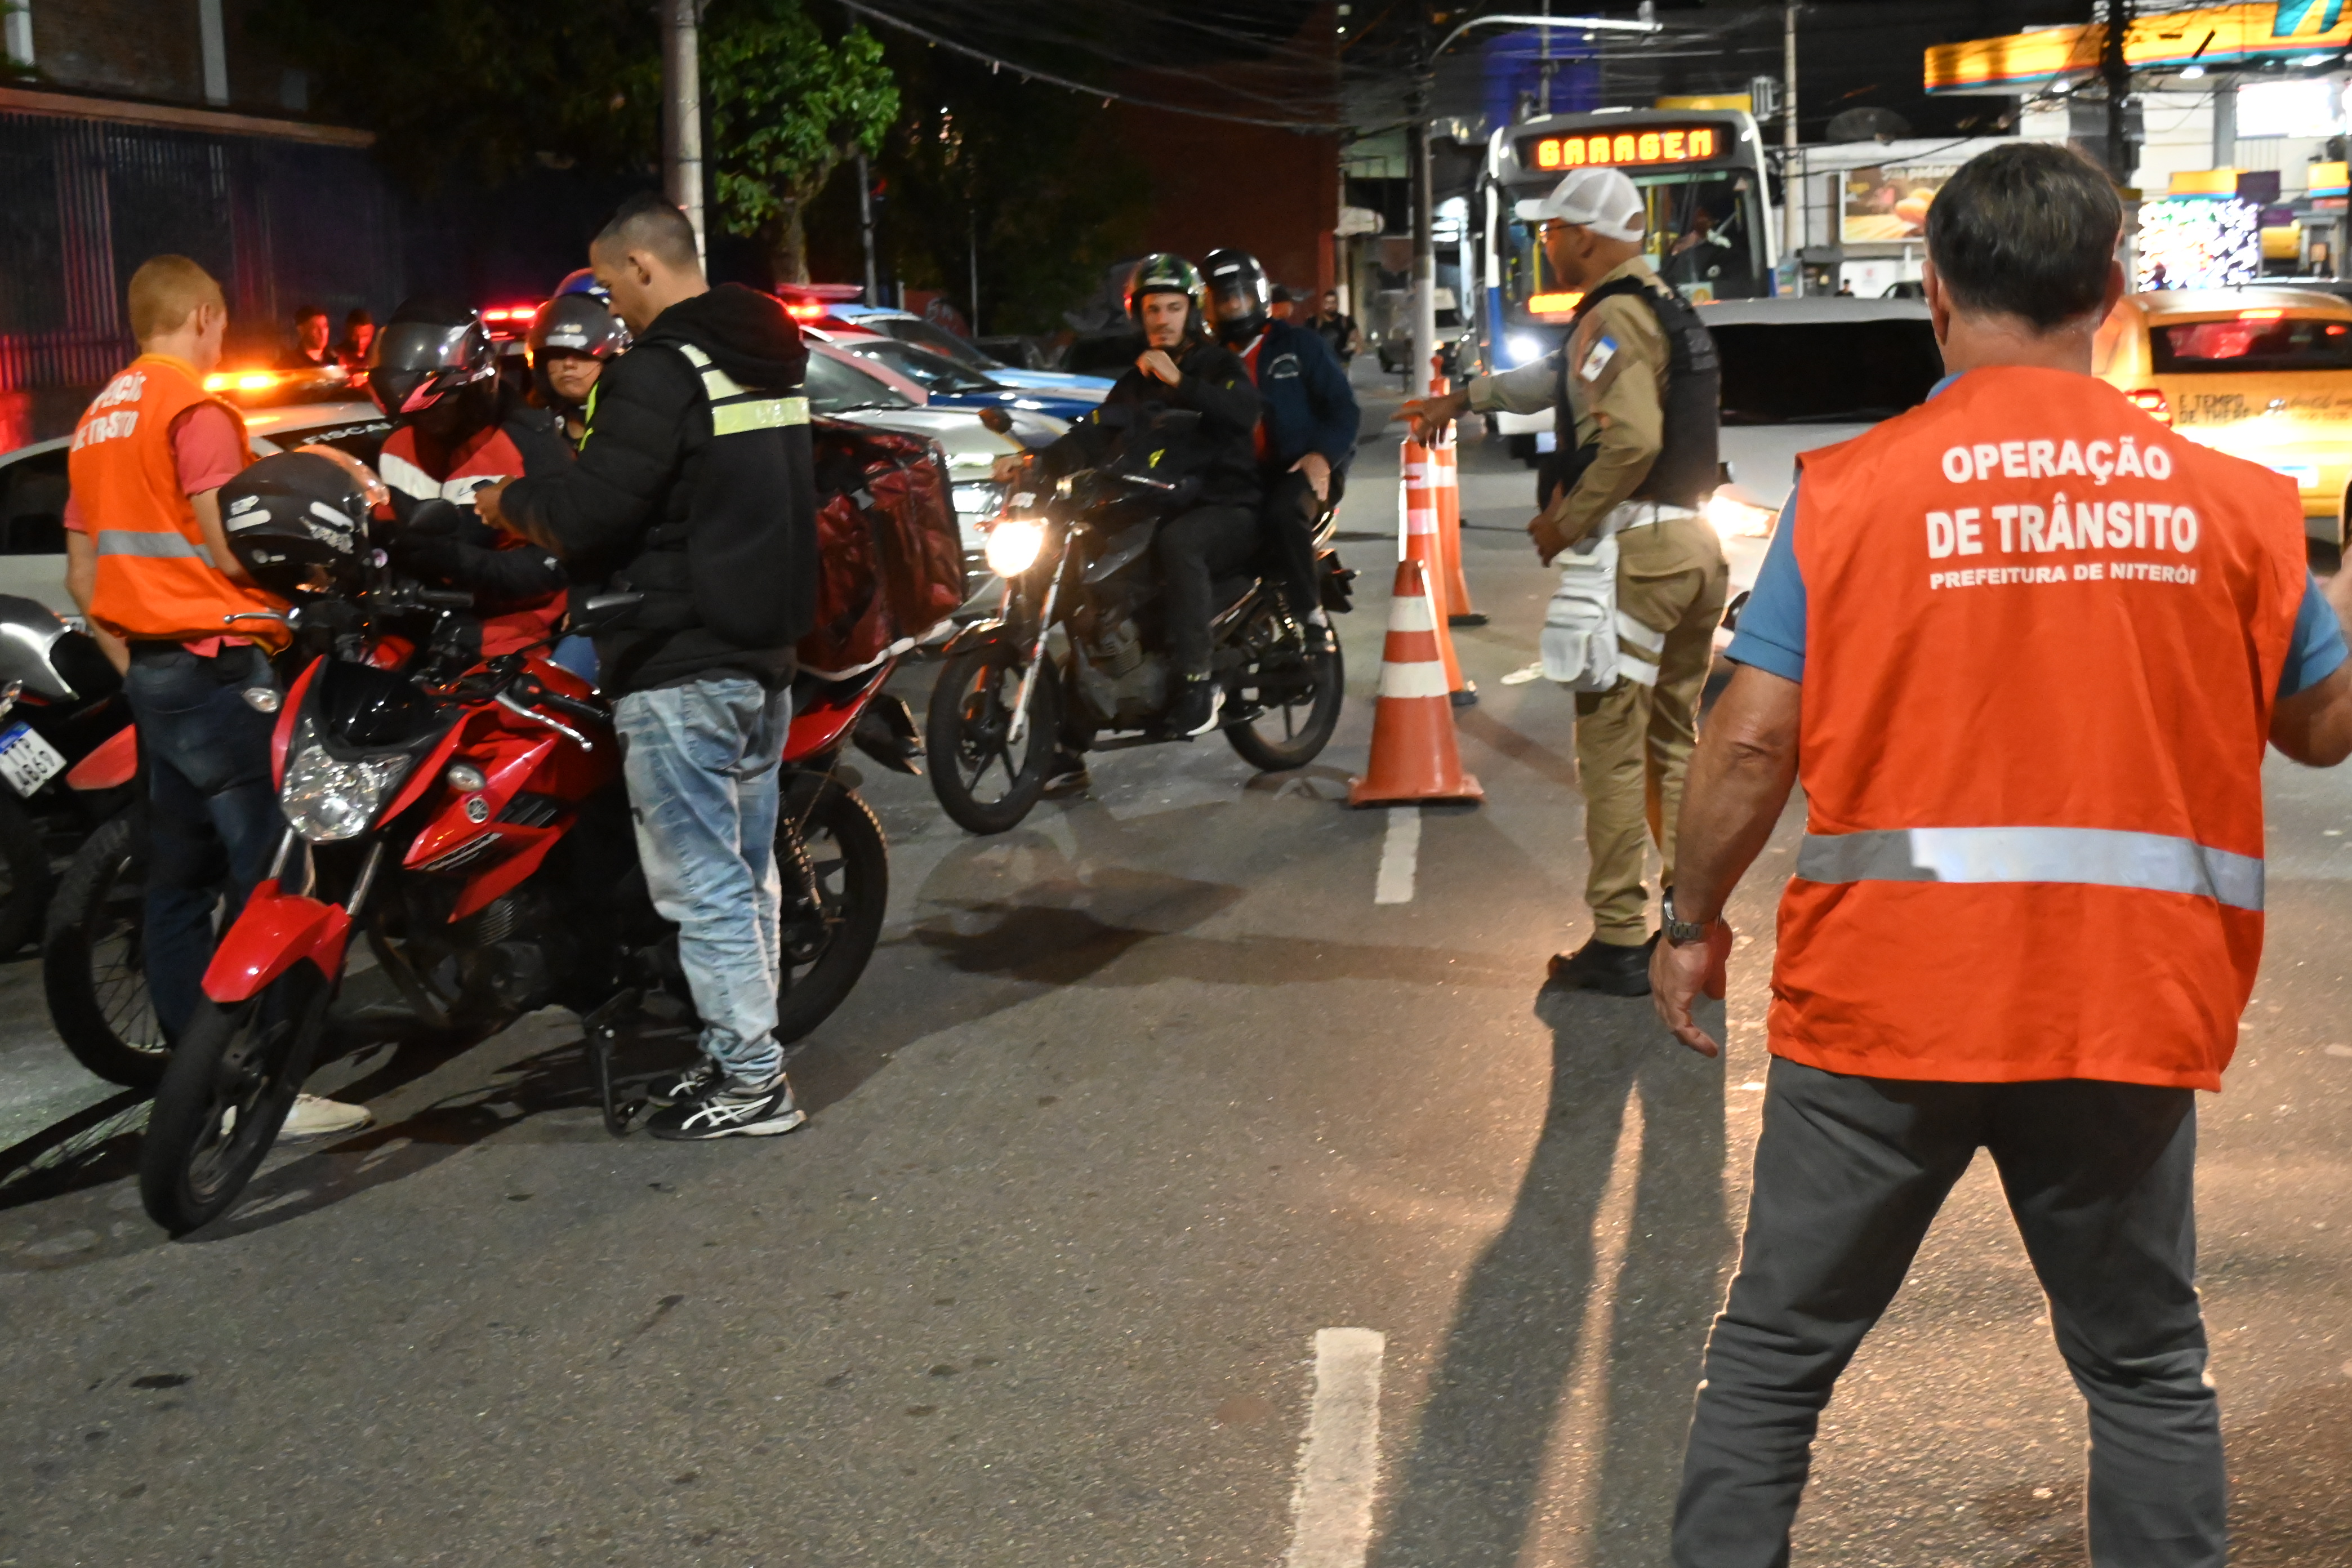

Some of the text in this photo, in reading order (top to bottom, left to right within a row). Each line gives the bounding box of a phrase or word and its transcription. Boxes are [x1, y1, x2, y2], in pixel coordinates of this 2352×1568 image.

[1539, 129, 1712, 167] GARAGEM
[1941, 435, 2172, 485] OPERAÇÃO
[1926, 491, 2199, 559] DE TRÂNSITO
[1930, 562, 2197, 590] PREFEITURA DE NITERÓI
